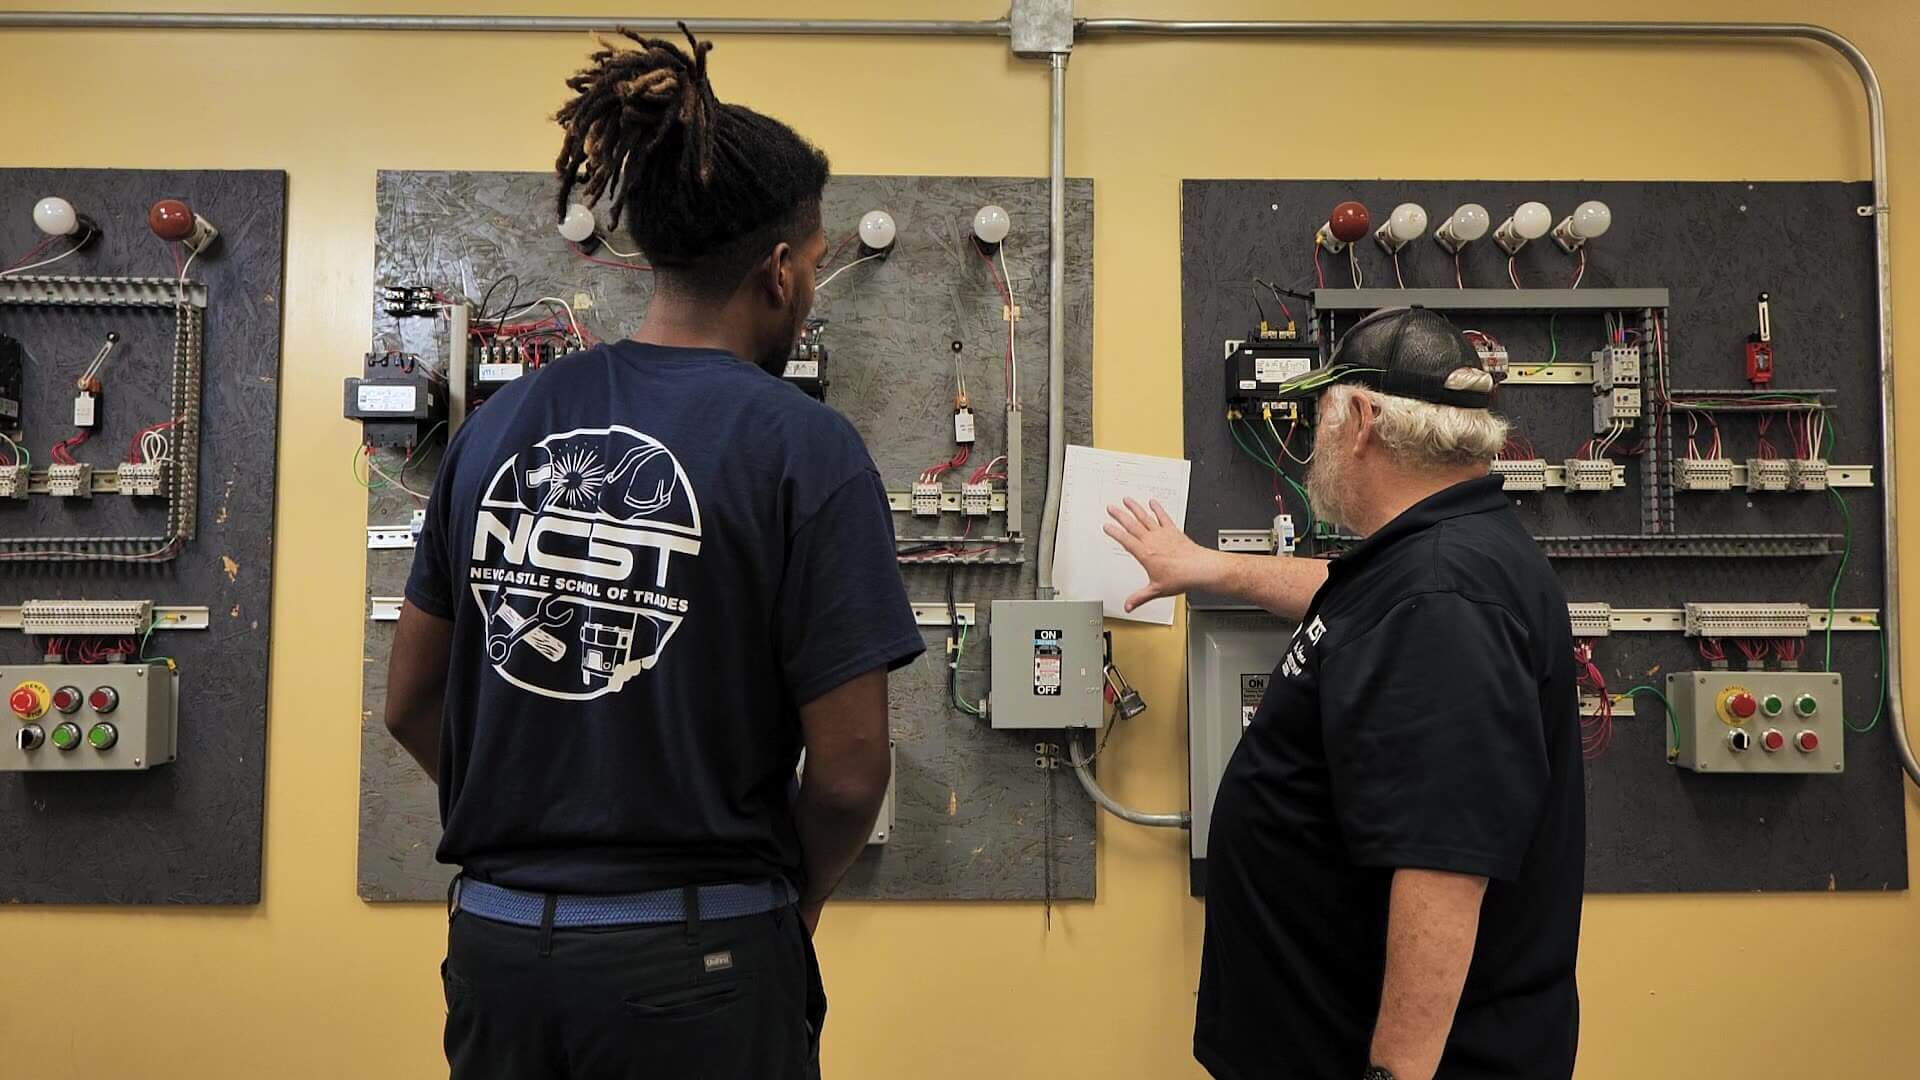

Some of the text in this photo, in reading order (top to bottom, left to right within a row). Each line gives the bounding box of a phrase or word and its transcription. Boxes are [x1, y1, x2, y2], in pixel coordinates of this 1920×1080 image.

[472, 511, 702, 588] NCST
[607, 587, 628, 600] OF
[633, 590, 689, 613] TRADES
[1041, 631, 1056, 639] ON
[1248, 679, 1264, 688] ON
[1037, 685, 1057, 695] OFF
